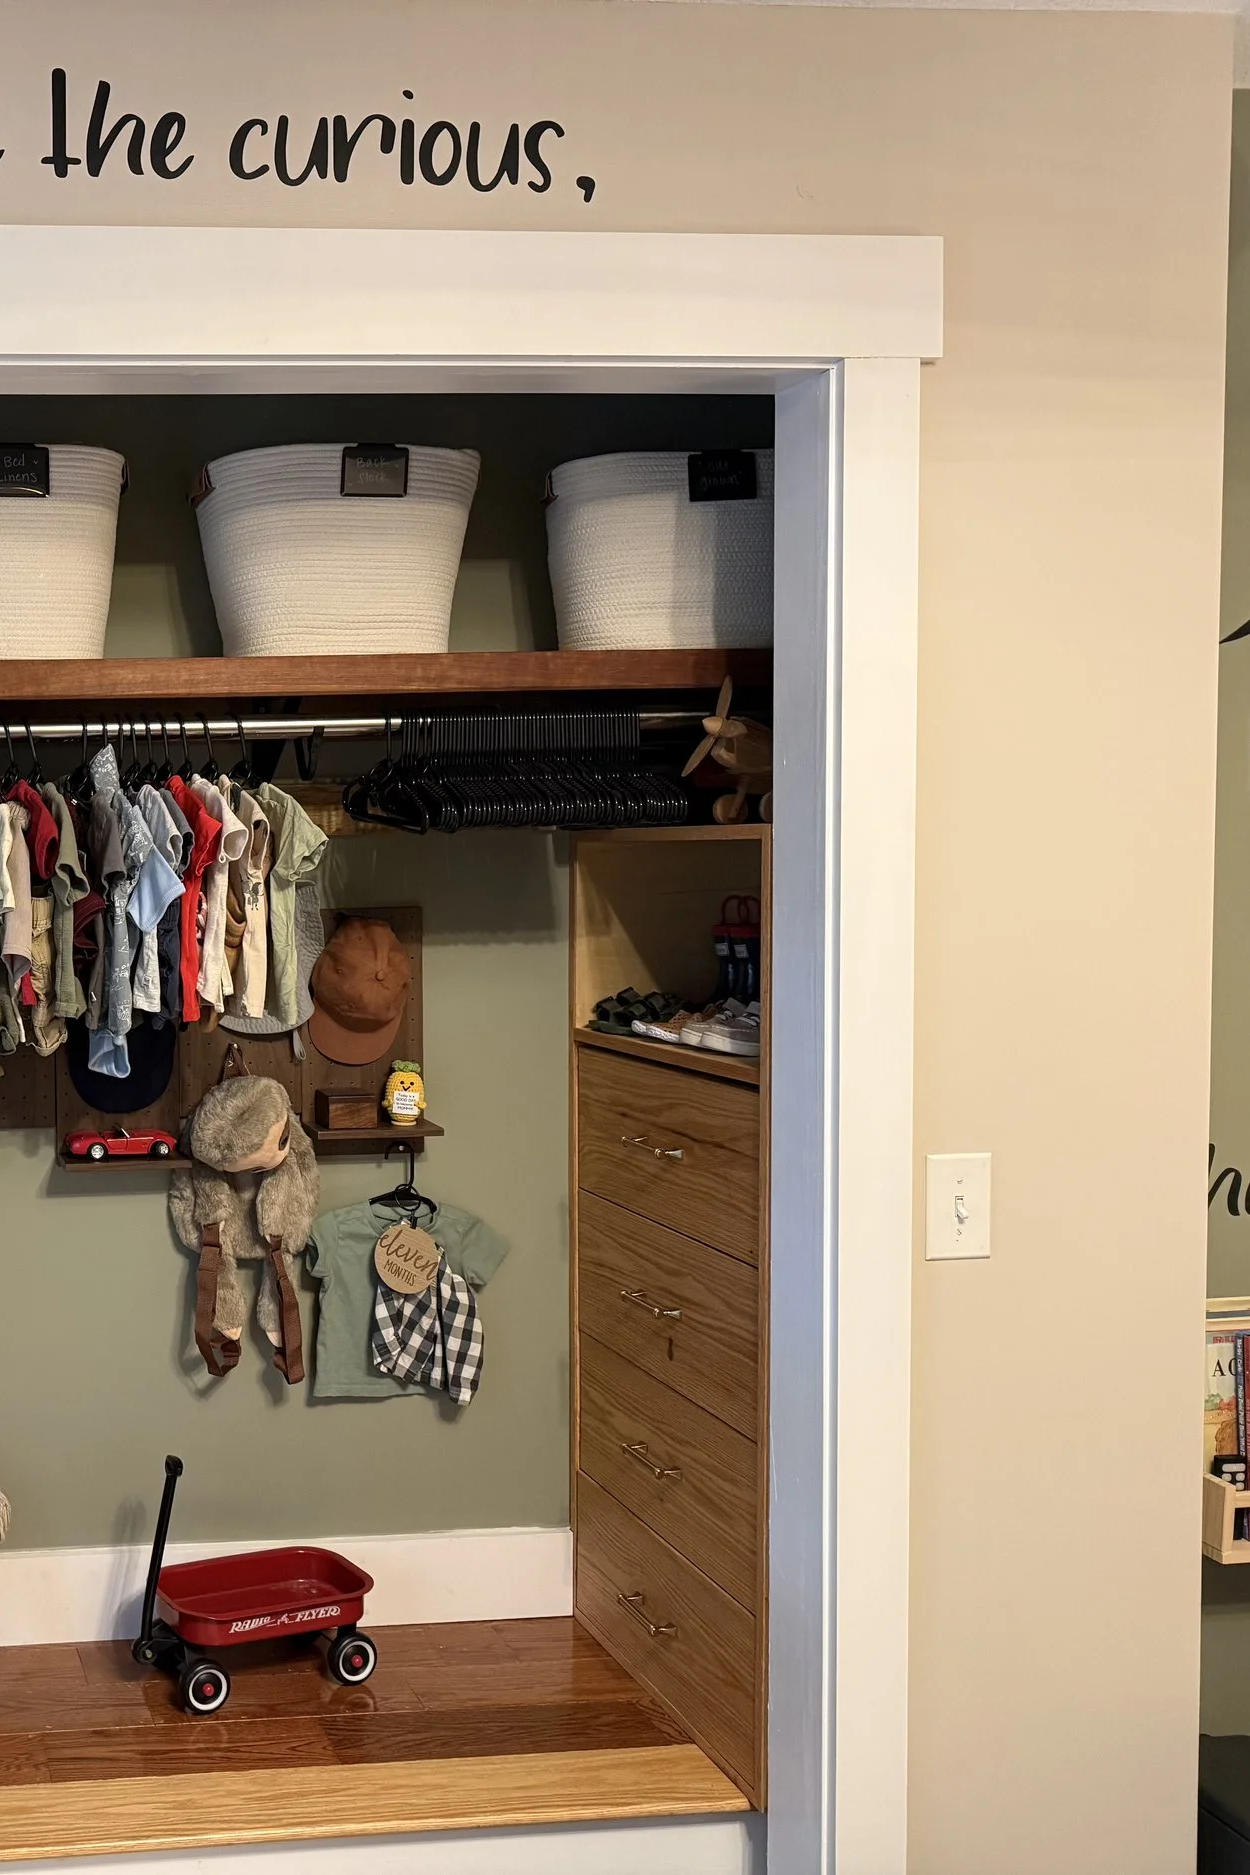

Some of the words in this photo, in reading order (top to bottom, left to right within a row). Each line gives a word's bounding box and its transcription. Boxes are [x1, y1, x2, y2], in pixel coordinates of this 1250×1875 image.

[40, 67, 195, 180] the
[228, 88, 596, 203] curious,
[3, 453, 25, 468] Bed
[379, 1229, 438, 1281] eleven
[383, 1259, 417, 1287] MONTHS
[229, 1616, 271, 1633] RADIO
[295, 1606, 341, 1622] FLYER
